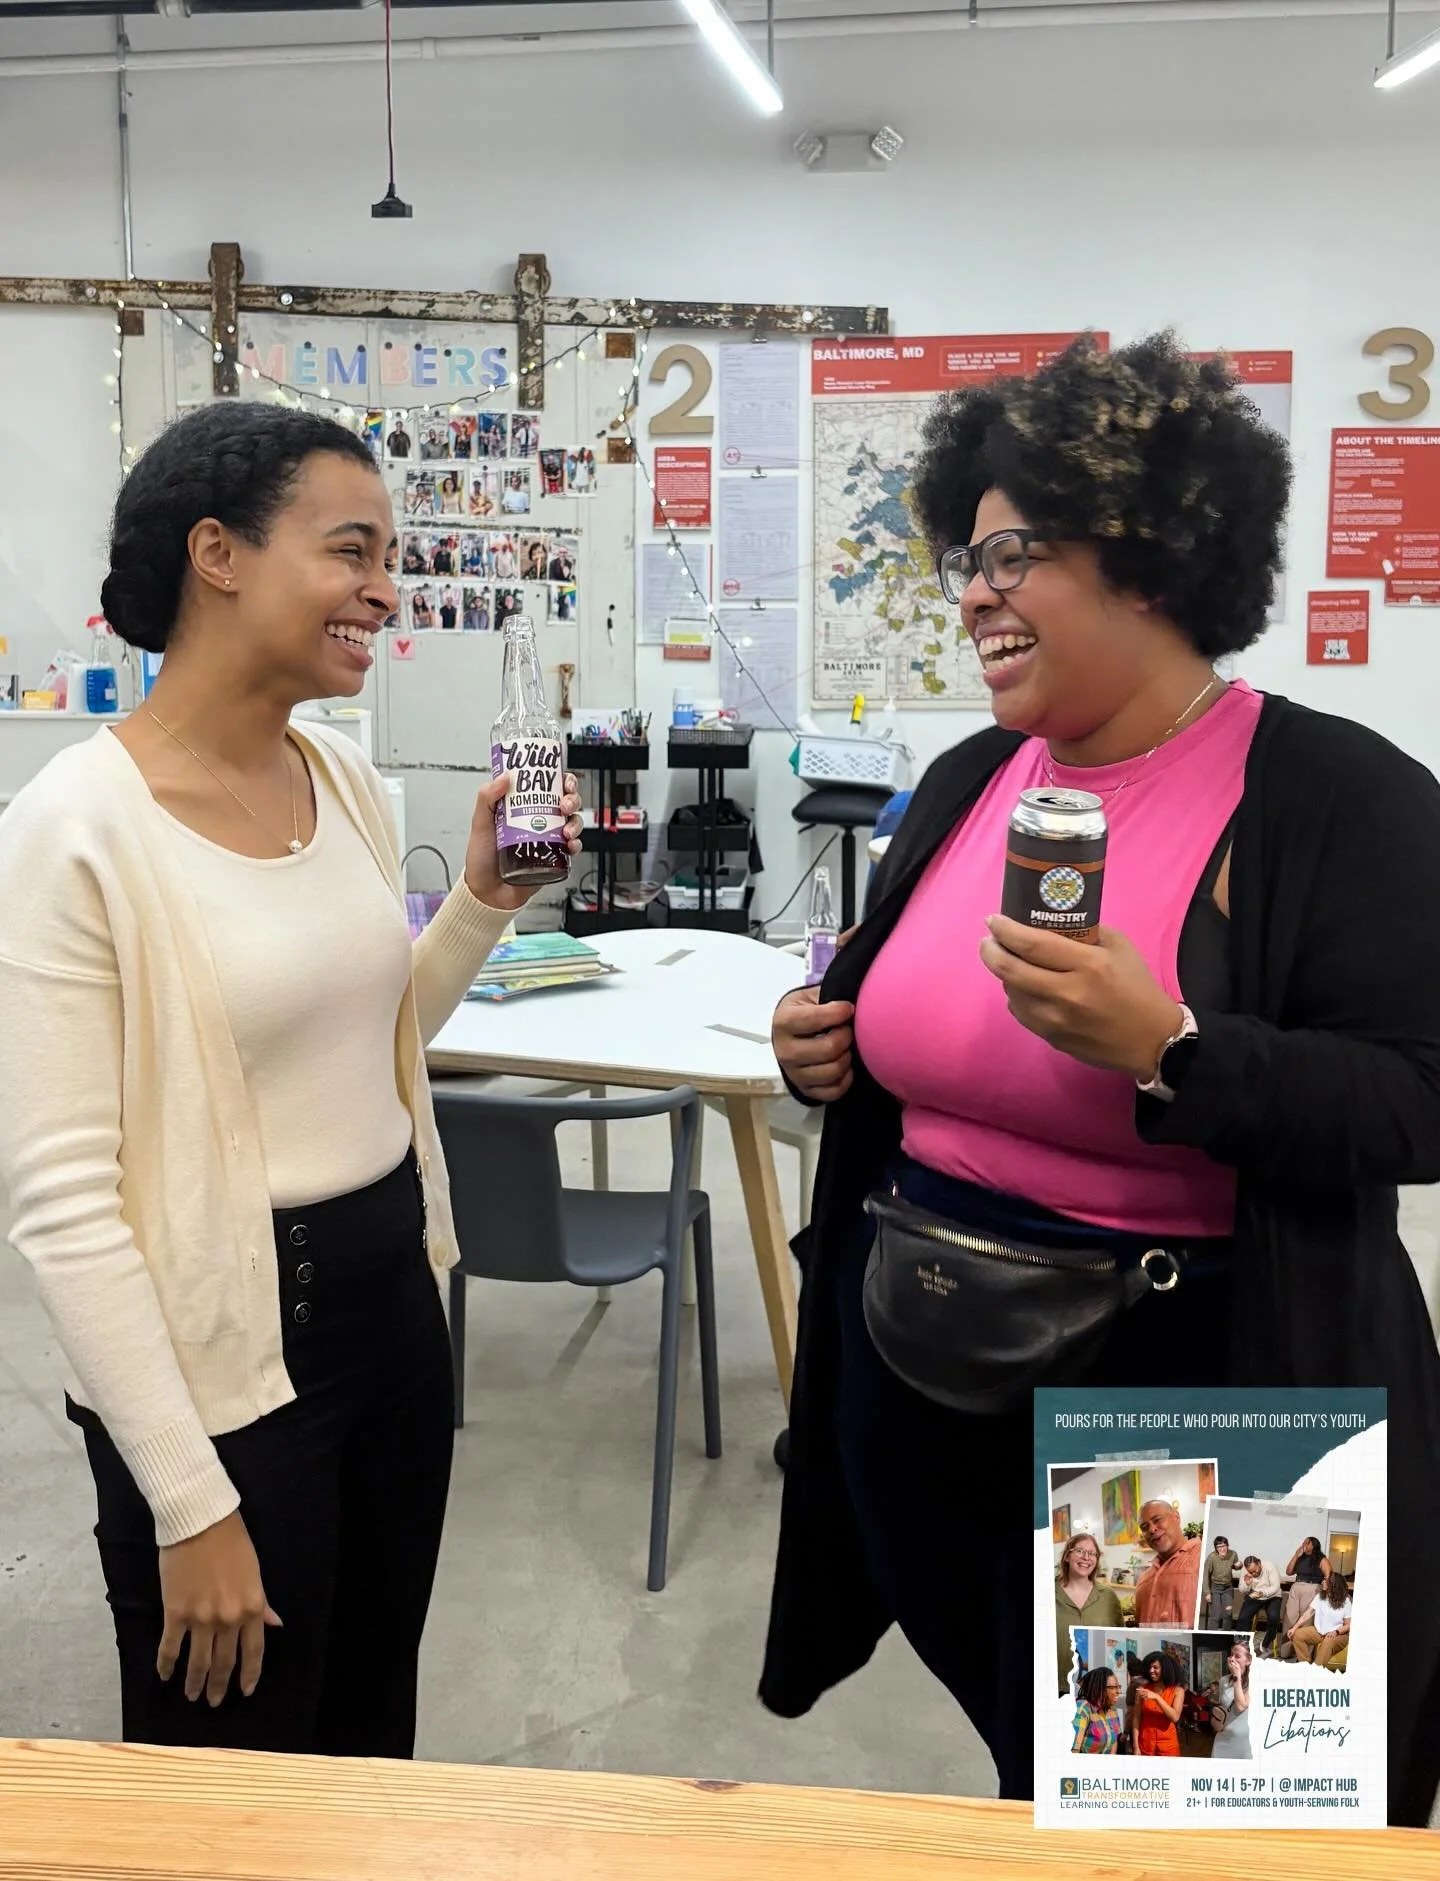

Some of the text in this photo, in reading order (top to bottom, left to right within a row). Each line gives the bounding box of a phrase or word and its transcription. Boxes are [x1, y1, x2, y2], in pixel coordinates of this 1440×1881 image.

[242, 343, 508, 387] MEMBERS
[813, 347, 925, 360] BALTIMORE, MD
[1357, 327, 1434, 421] 3
[648, 343, 714, 434] 2
[1335, 436, 1371, 445] ABOUT
[1373, 436, 1394, 445] THE
[823, 663, 880, 671] BALTIMORE
[500, 742, 561, 770] Wild
[516, 769, 557, 793] BAY
[1030, 910, 1088, 922] MINISTRY
